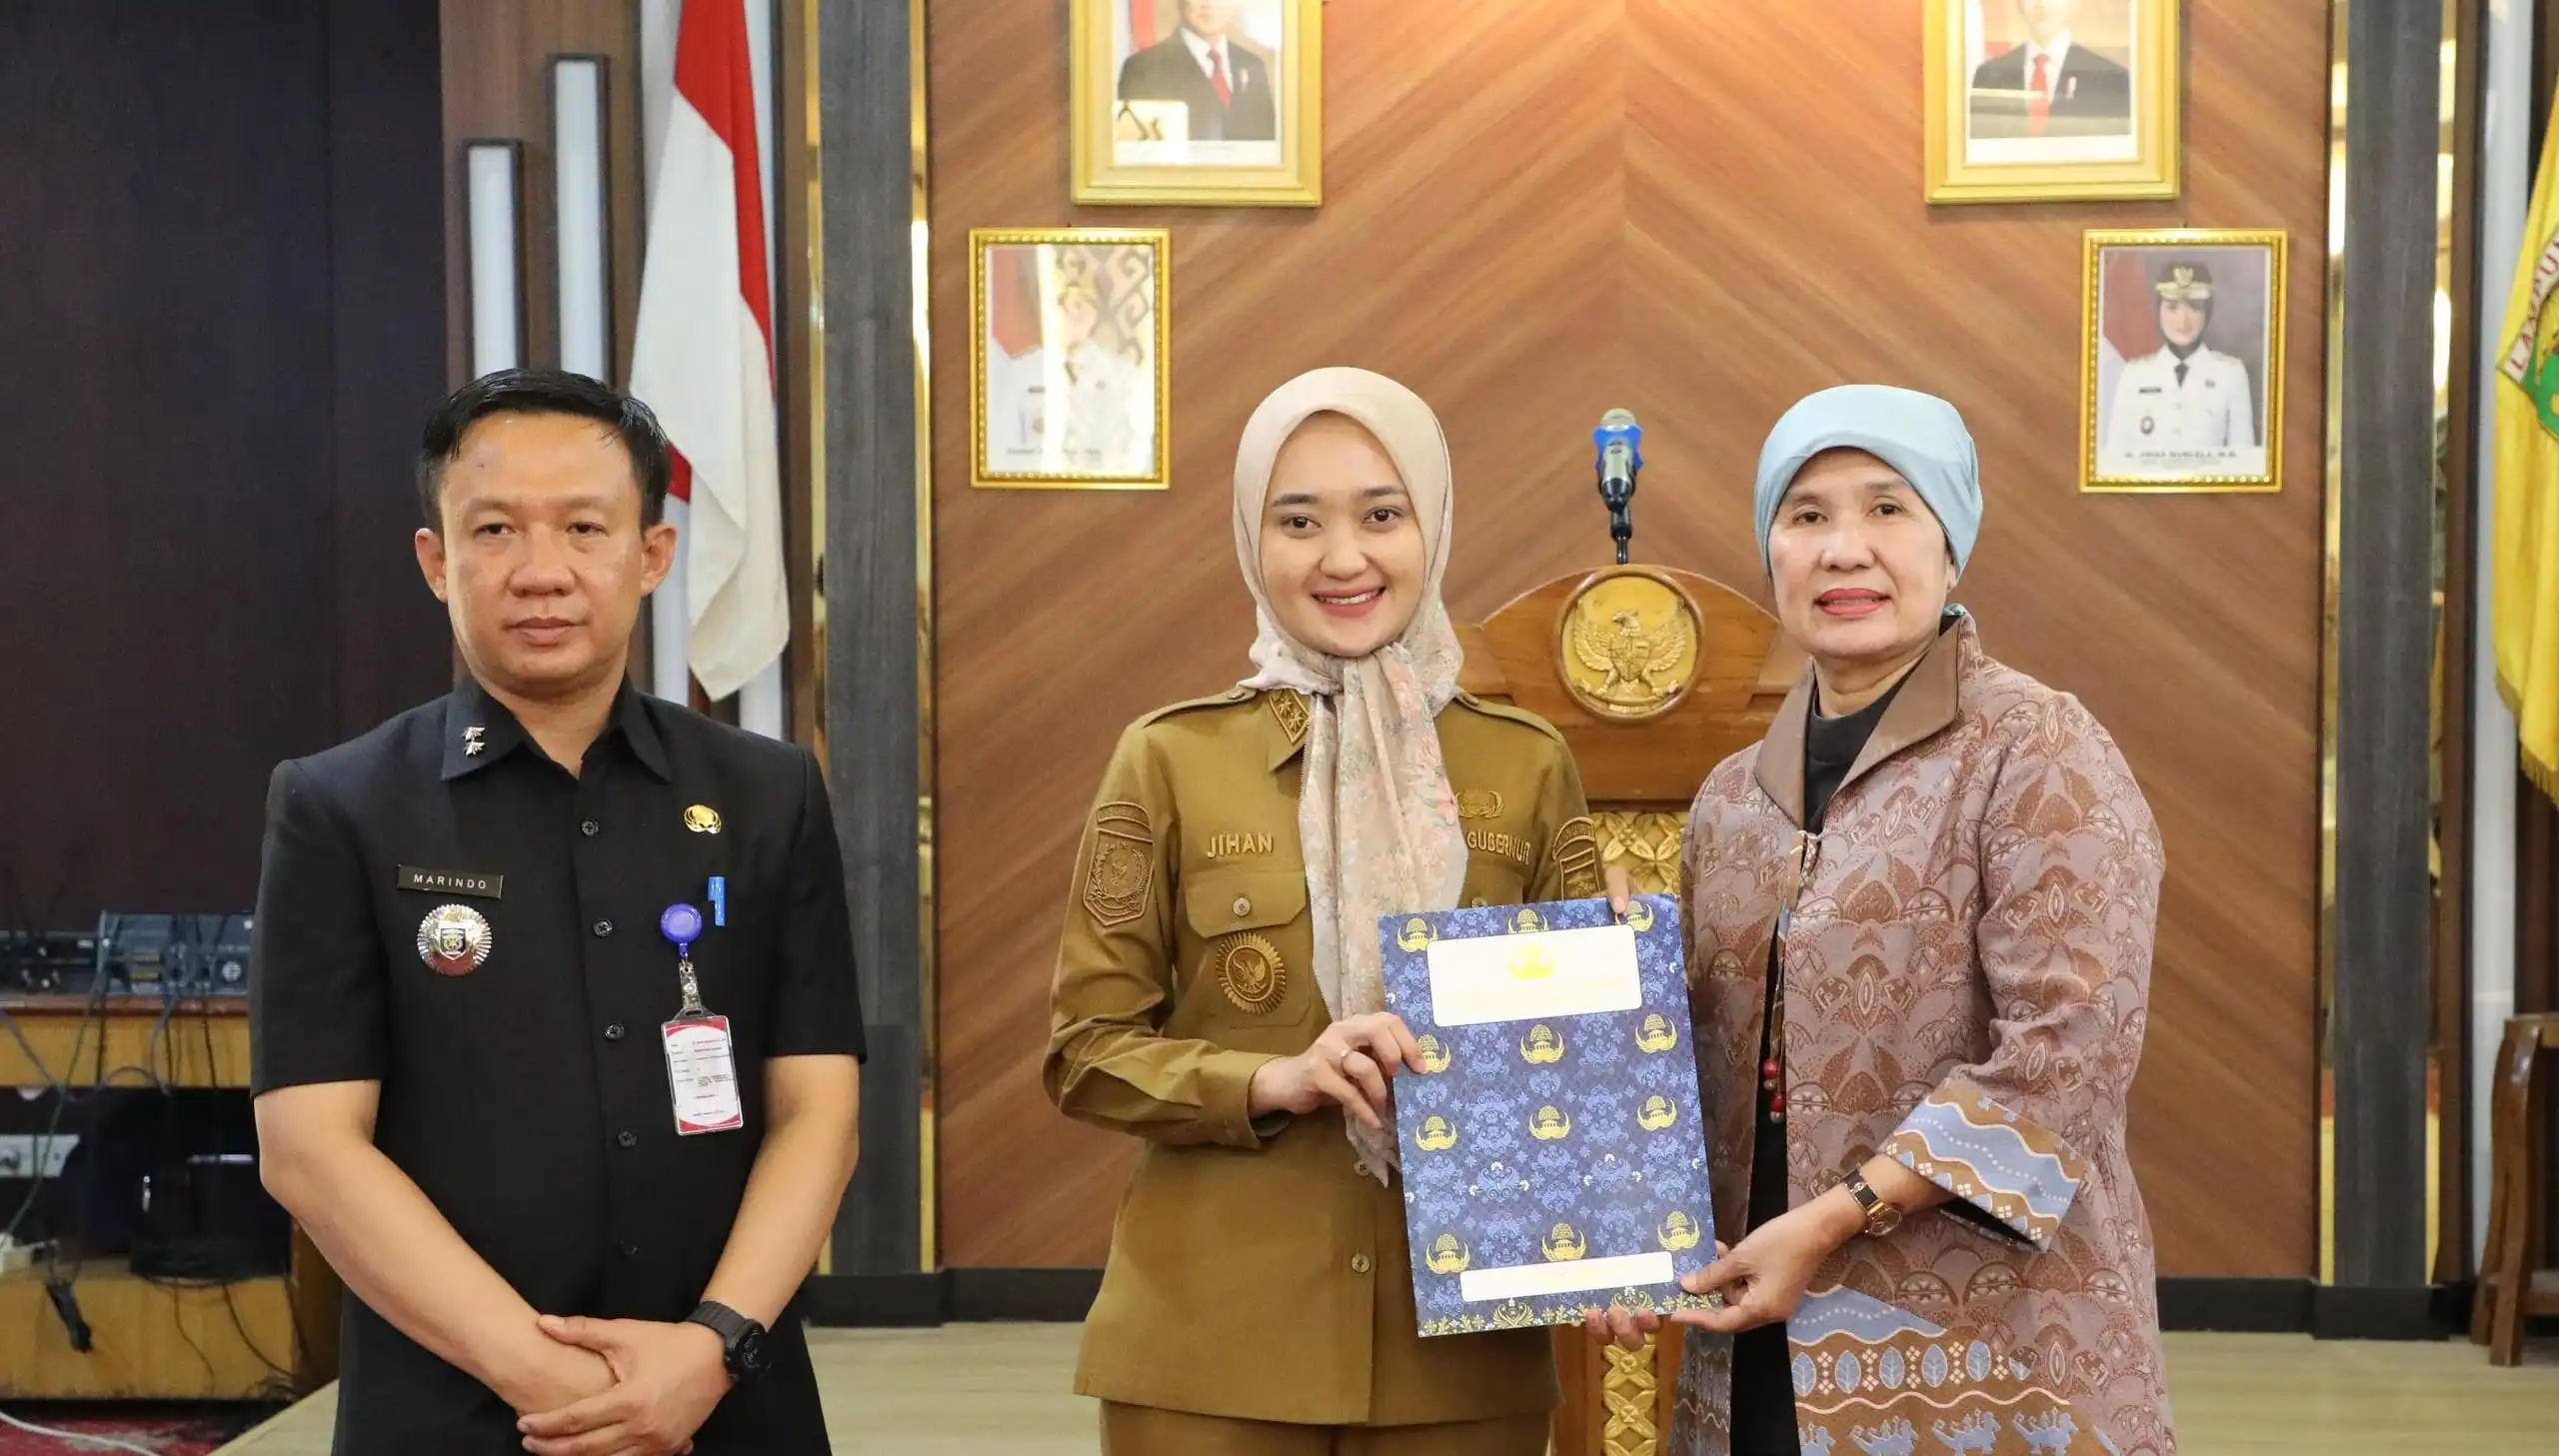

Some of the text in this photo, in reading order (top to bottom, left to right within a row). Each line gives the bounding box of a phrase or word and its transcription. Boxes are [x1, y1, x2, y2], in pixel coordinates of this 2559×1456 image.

[1207, 831, 1273, 858] JIHAN
[1466, 829, 1530, 865] GUBERNUR
[413, 873, 487, 889] MARINDO
